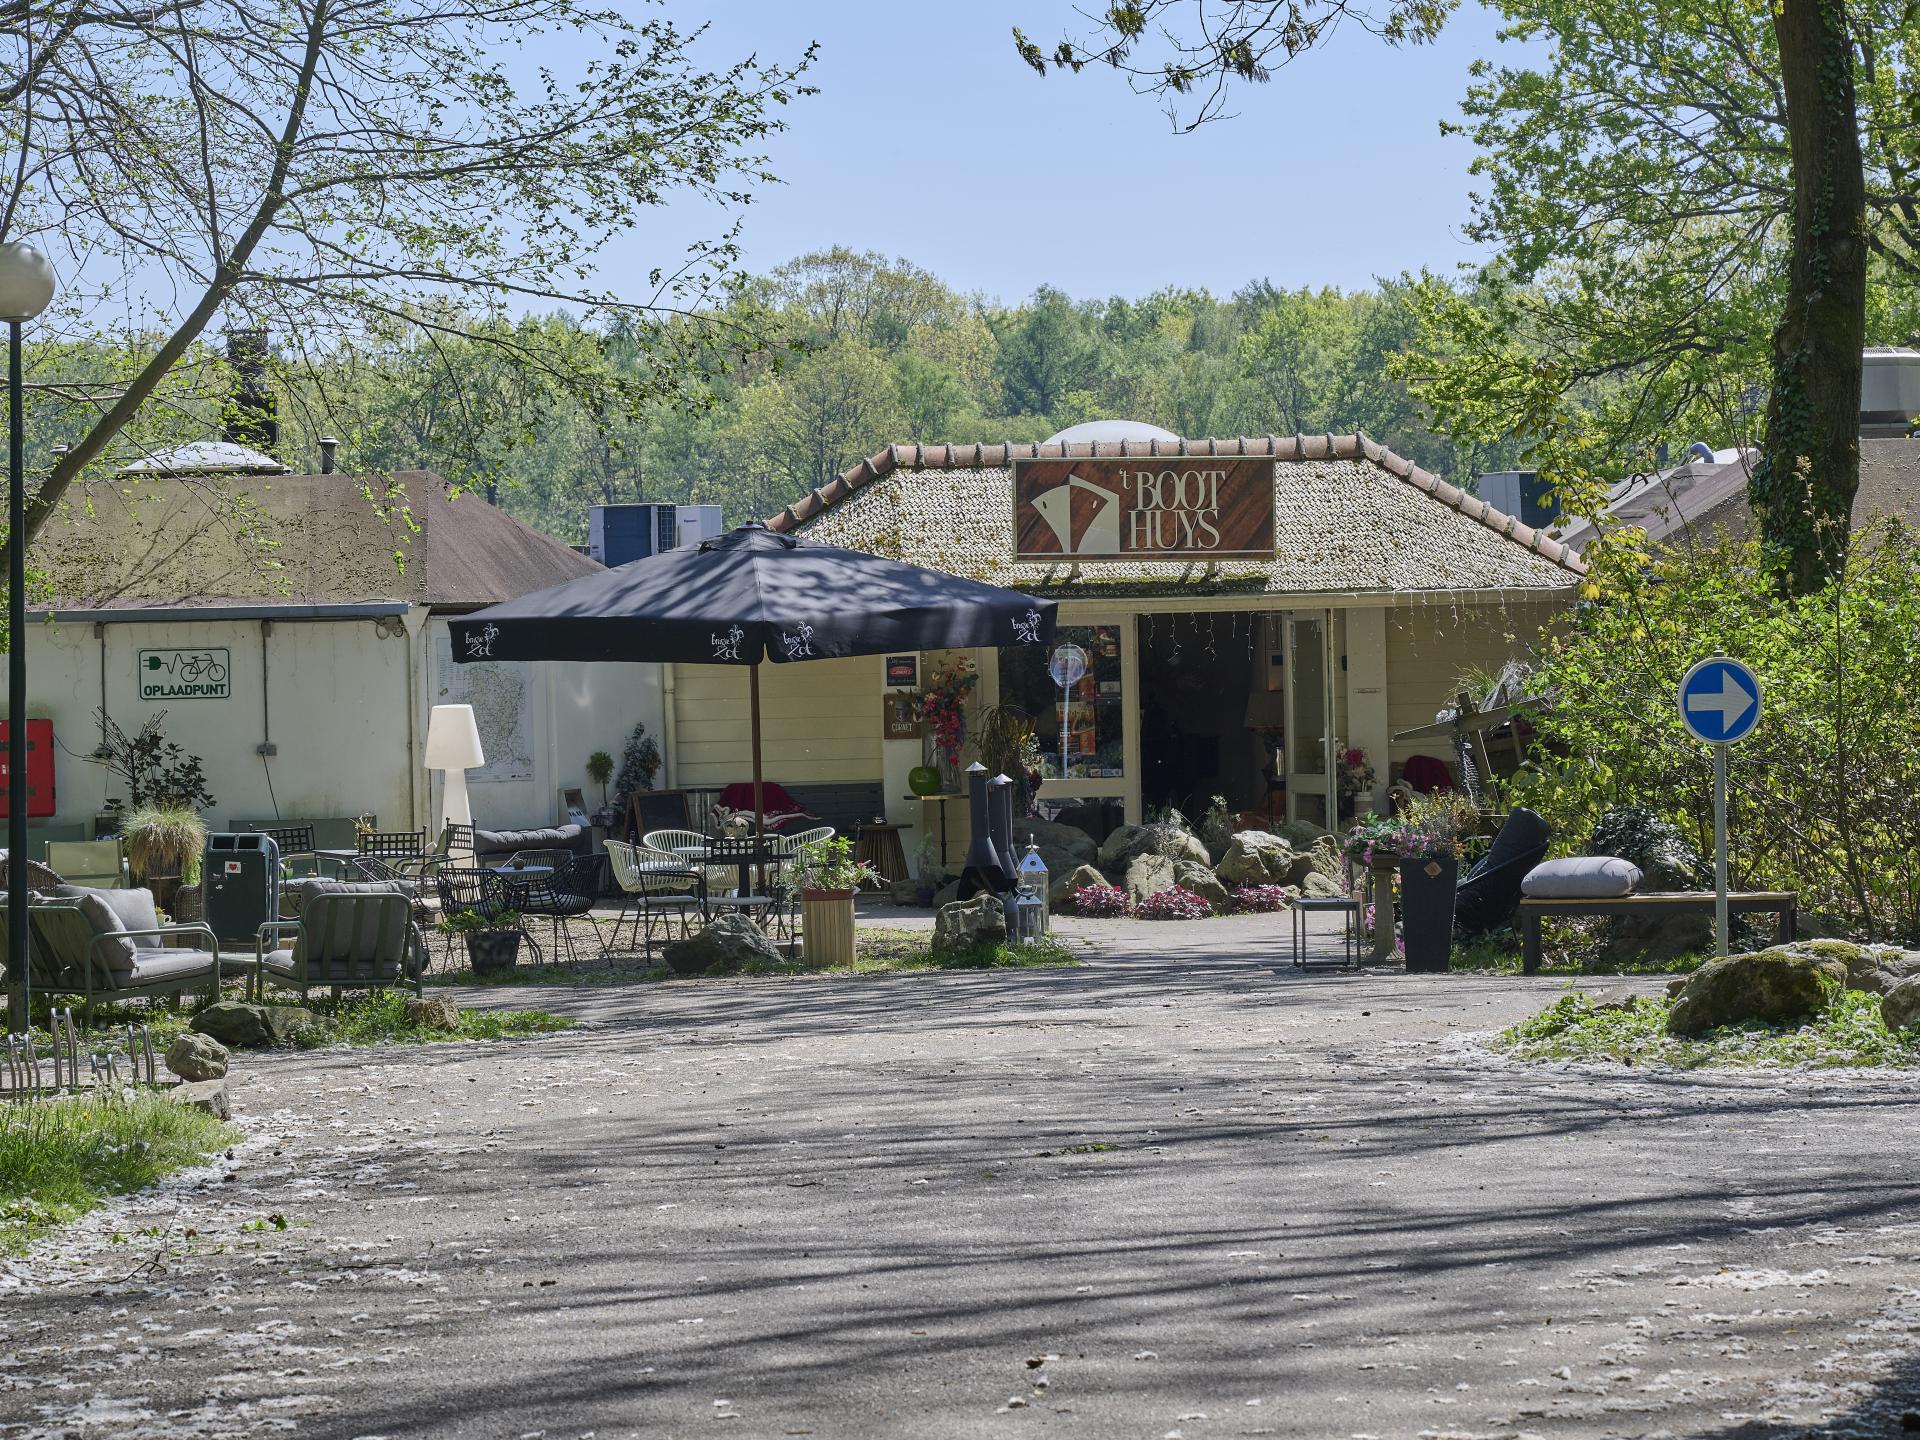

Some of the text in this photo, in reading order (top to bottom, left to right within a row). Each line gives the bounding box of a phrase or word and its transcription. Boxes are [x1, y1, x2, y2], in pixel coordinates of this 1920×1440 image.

[1134, 470, 1226, 511] BOOT
[1128, 509, 1220, 549] HUYS
[143, 684, 227, 696] OPLAADPUNT
